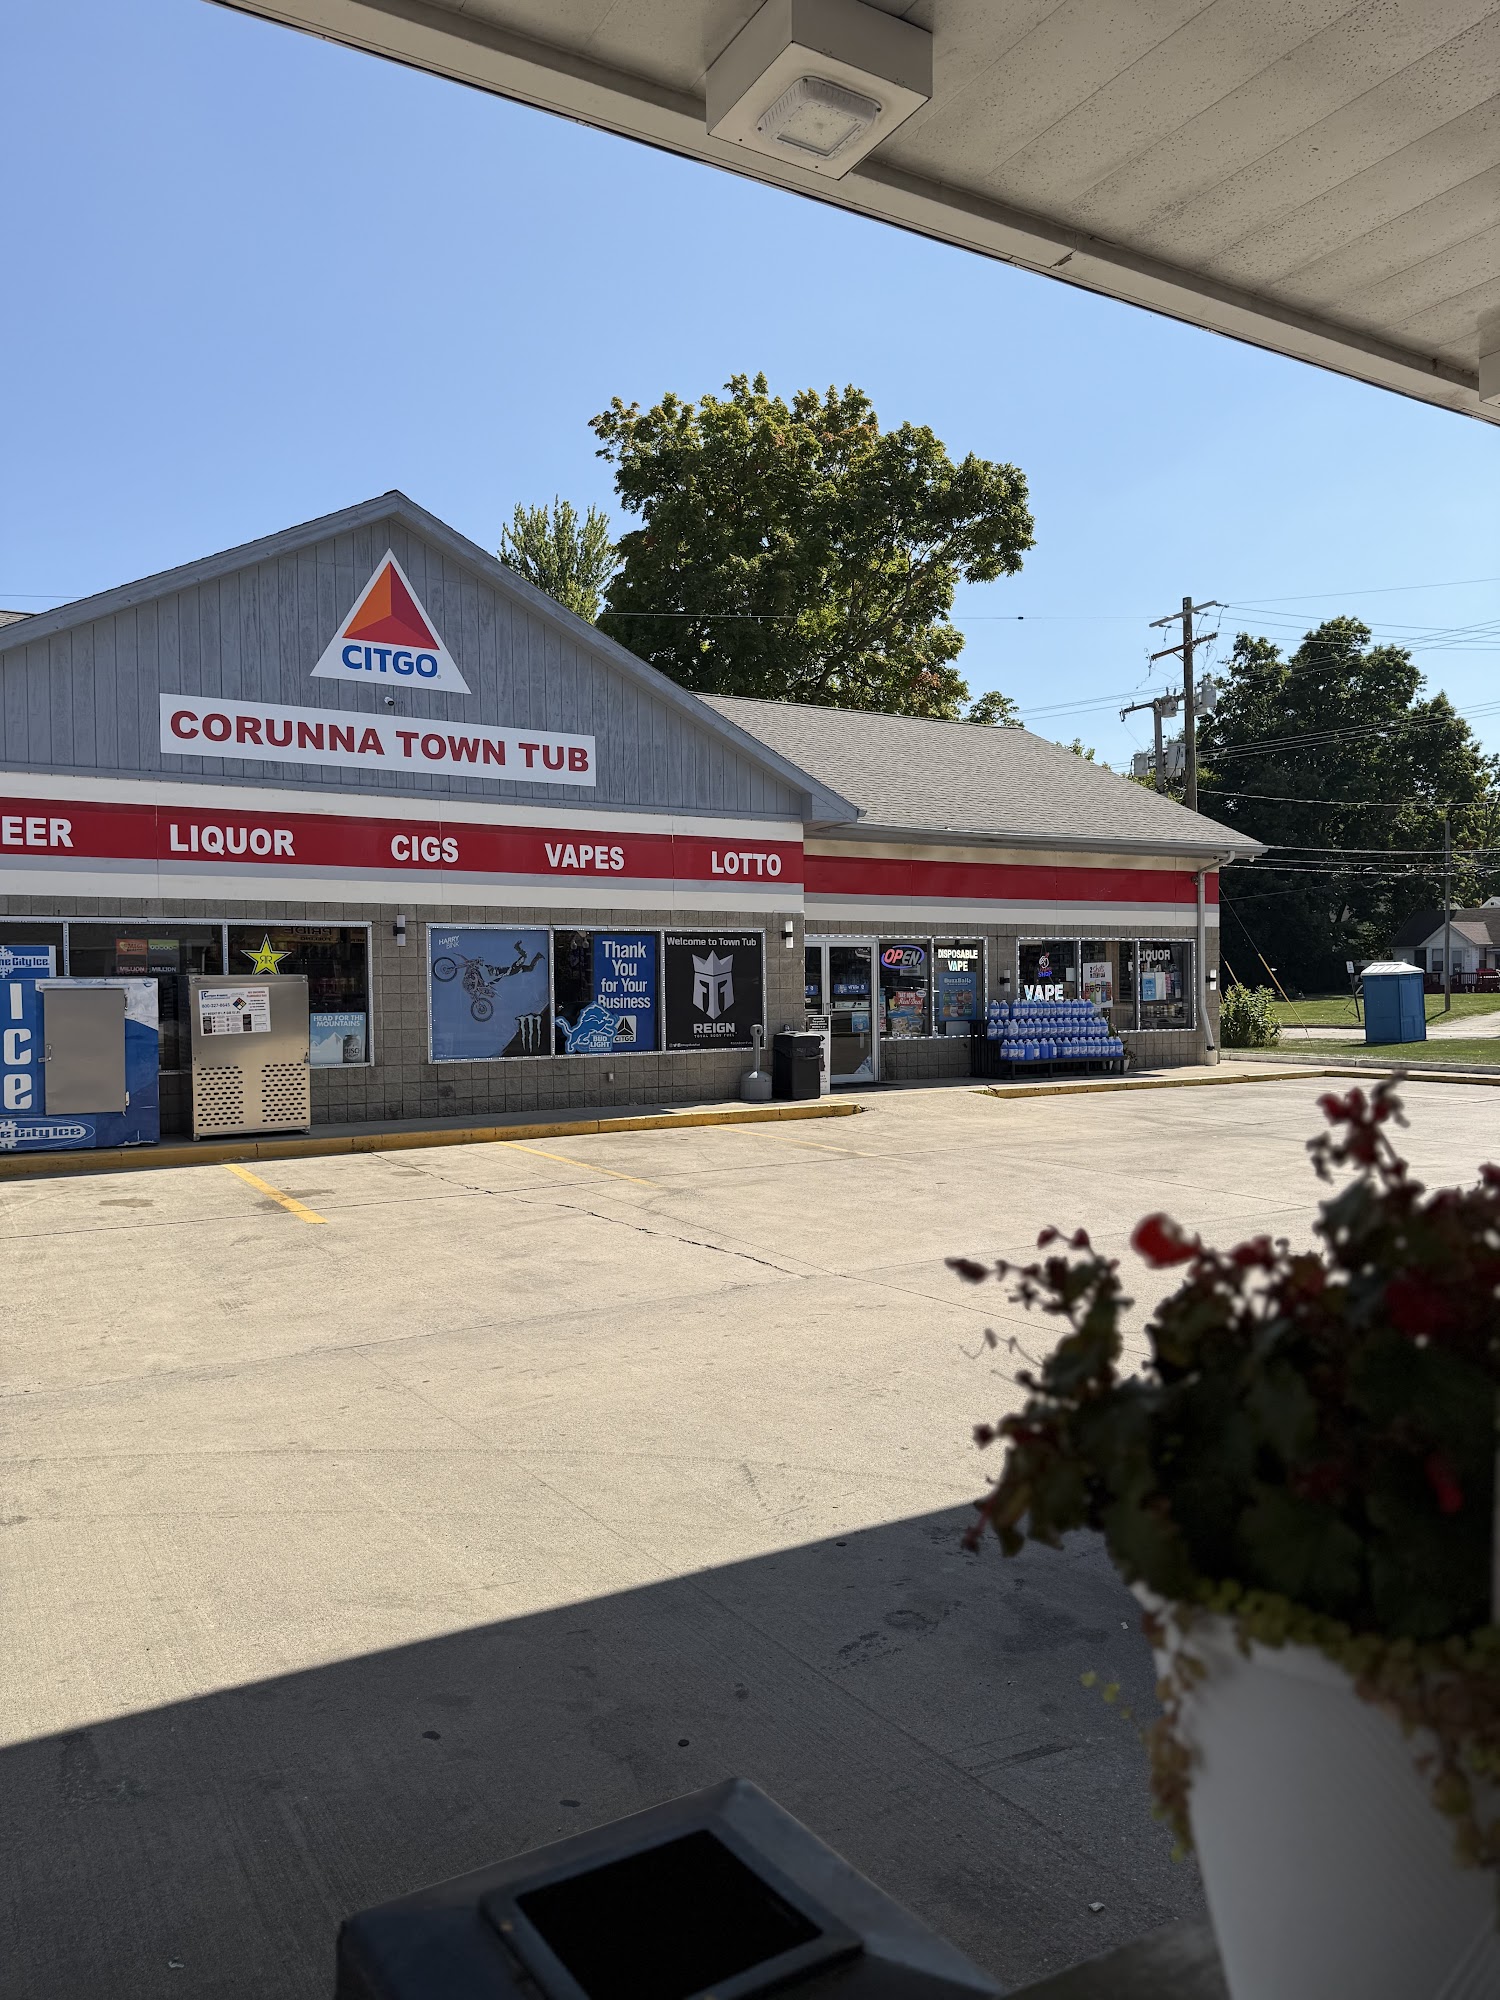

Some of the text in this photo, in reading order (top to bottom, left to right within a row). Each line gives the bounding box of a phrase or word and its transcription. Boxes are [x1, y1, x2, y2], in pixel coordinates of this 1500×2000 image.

[341, 644, 438, 678] CITGO
[170, 710, 590, 773] CORUNNA TOWN TUB
[169, 823, 295, 857] LIQUOR
[390, 834, 459, 863] CIGS
[544, 842, 625, 871] VAPES
[710, 850, 782, 877] LOTTO
[438, 935, 460, 945] HARRY
[666, 936, 757, 946] Welcome to Town Tub
[602, 941, 647, 958] Thank
[884, 948, 920, 965] OPEN
[937, 949, 978, 959] DISPOSABLE
[1139, 949, 1171, 961] LIQUOR
[12, 957, 32, 968] City
[33, 957, 48, 966] Ice
[611, 959, 637, 976] You
[947, 960, 969, 972] VAPE
[601, 978, 647, 993] for Your
[1023, 984, 1064, 1001] VAPE
[597, 994, 651, 1009] Business
[693, 1022, 736, 1034] REIGN
[14, 1128, 50, 1139] City
[53, 1127, 81, 1137] Ice
